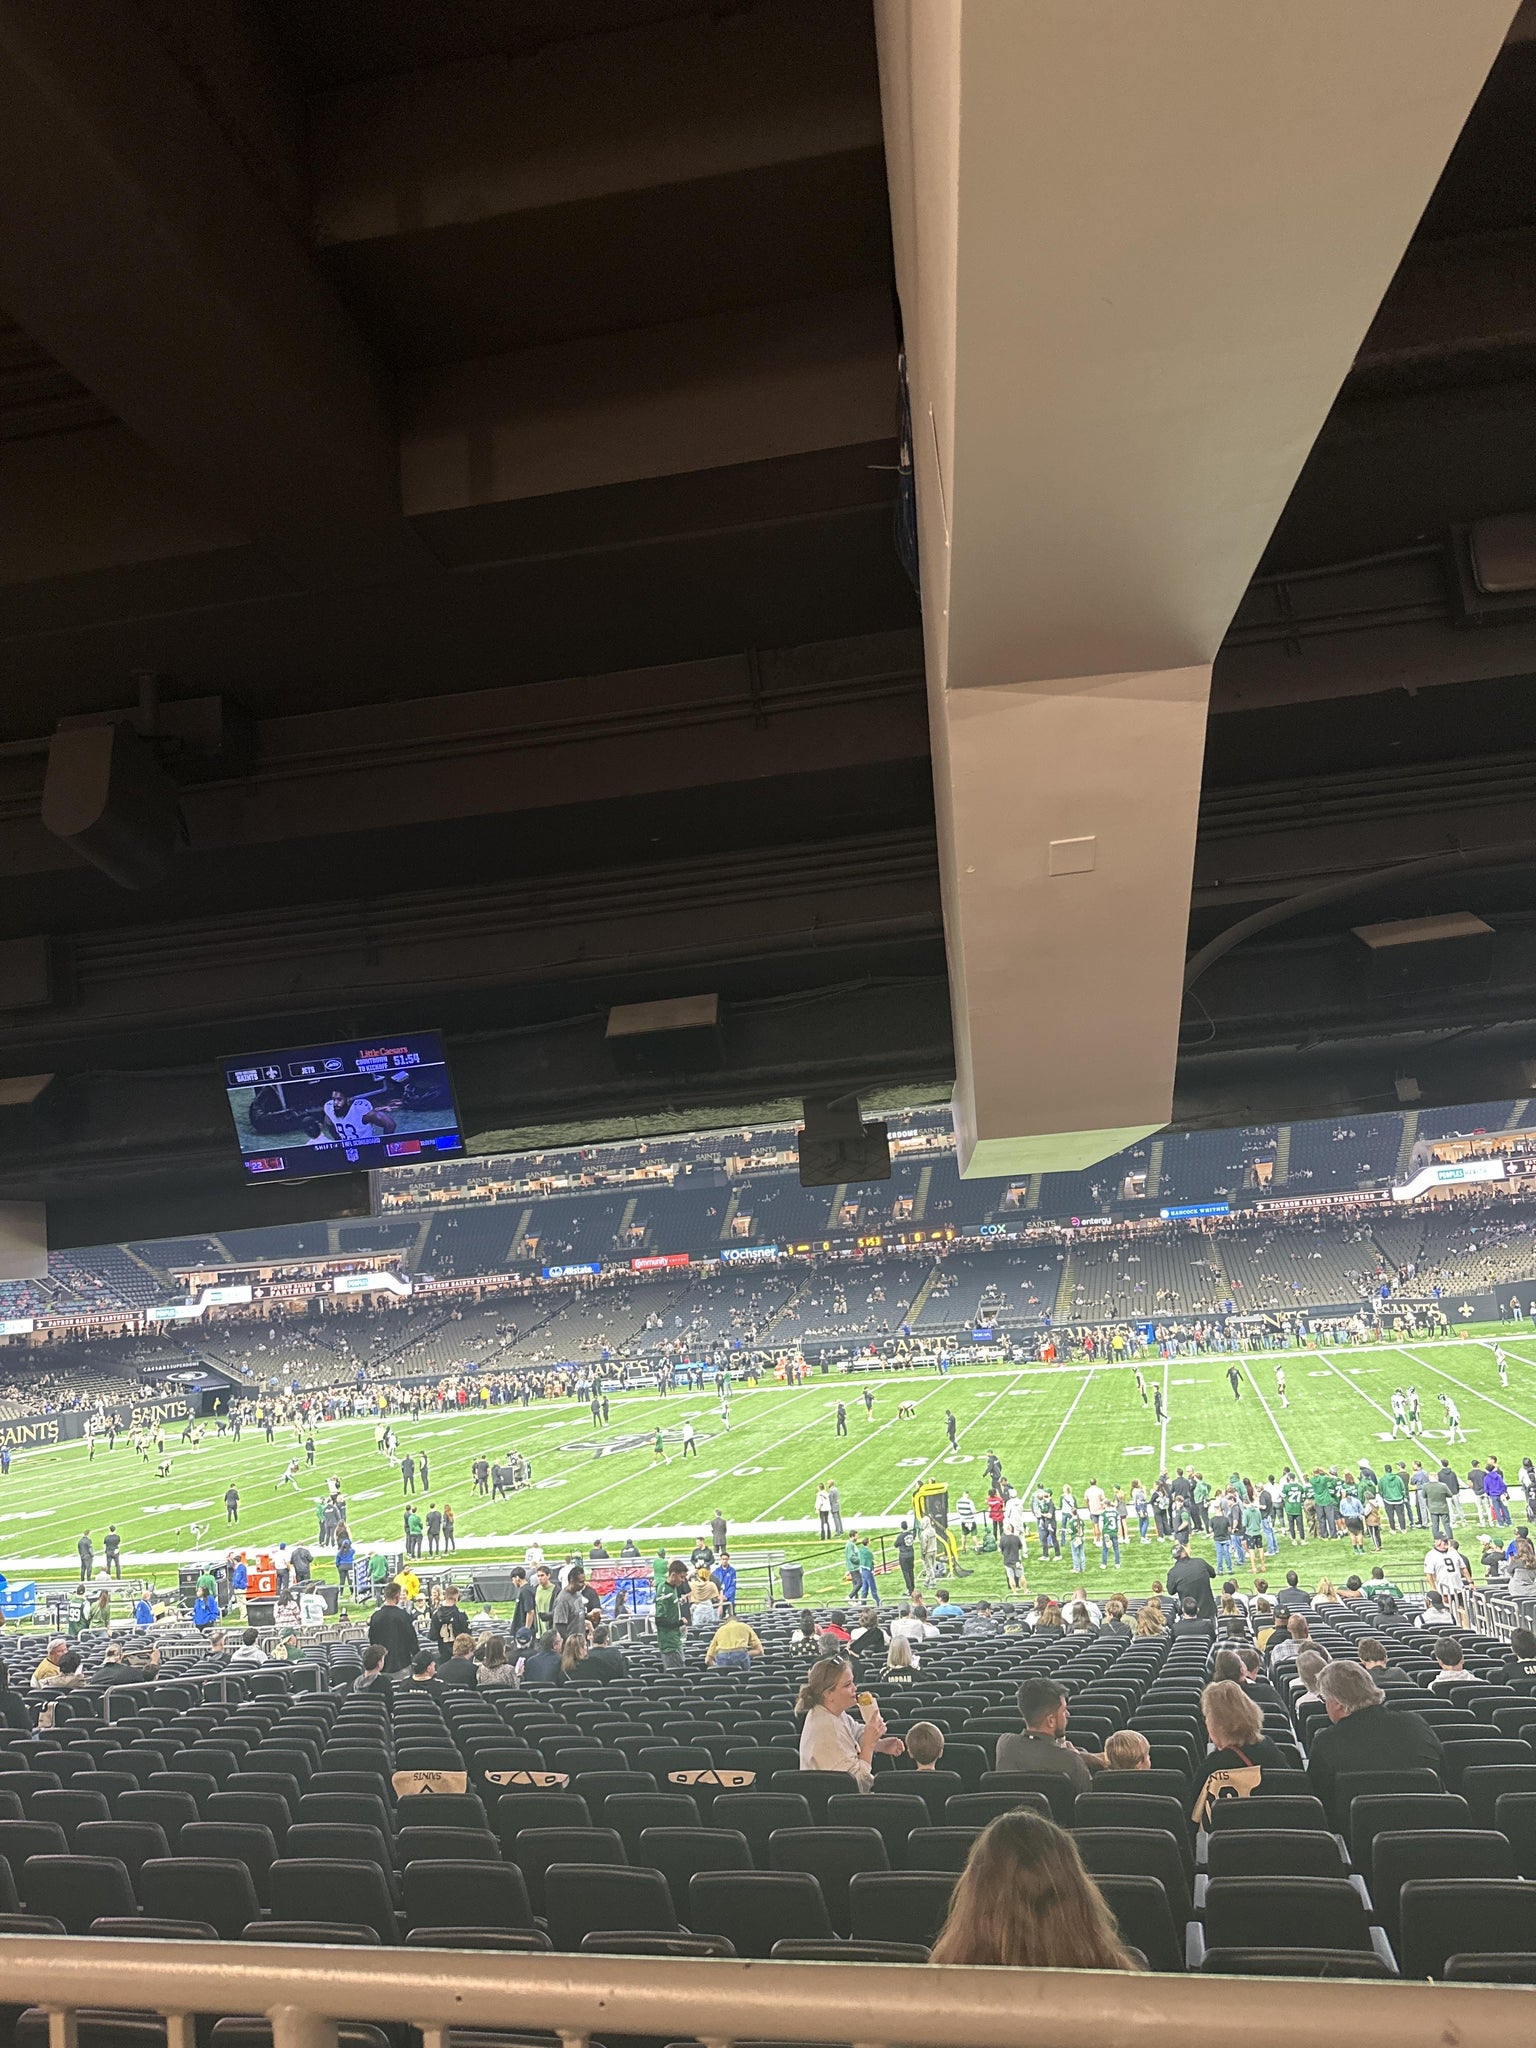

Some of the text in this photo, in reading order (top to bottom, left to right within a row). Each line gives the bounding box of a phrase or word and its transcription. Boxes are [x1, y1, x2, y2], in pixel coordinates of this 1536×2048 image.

[393, 1053, 420, 1065] 51:54
[301, 1066, 316, 1075] JETS
[887, 1129, 918, 1139] ERDOME
[1081, 1216, 1112, 1227] entergy
[980, 1224, 1006, 1235] COX
[730, 1246, 776, 1259] Ochsner
[132, 1400, 187, 1424] SAINTS
[1288, 1491, 1301, 1502] 27
[1443, 1558, 1456, 1573] 9
[258, 1577, 271, 1592] G
[69, 1609, 80, 1621] 99
